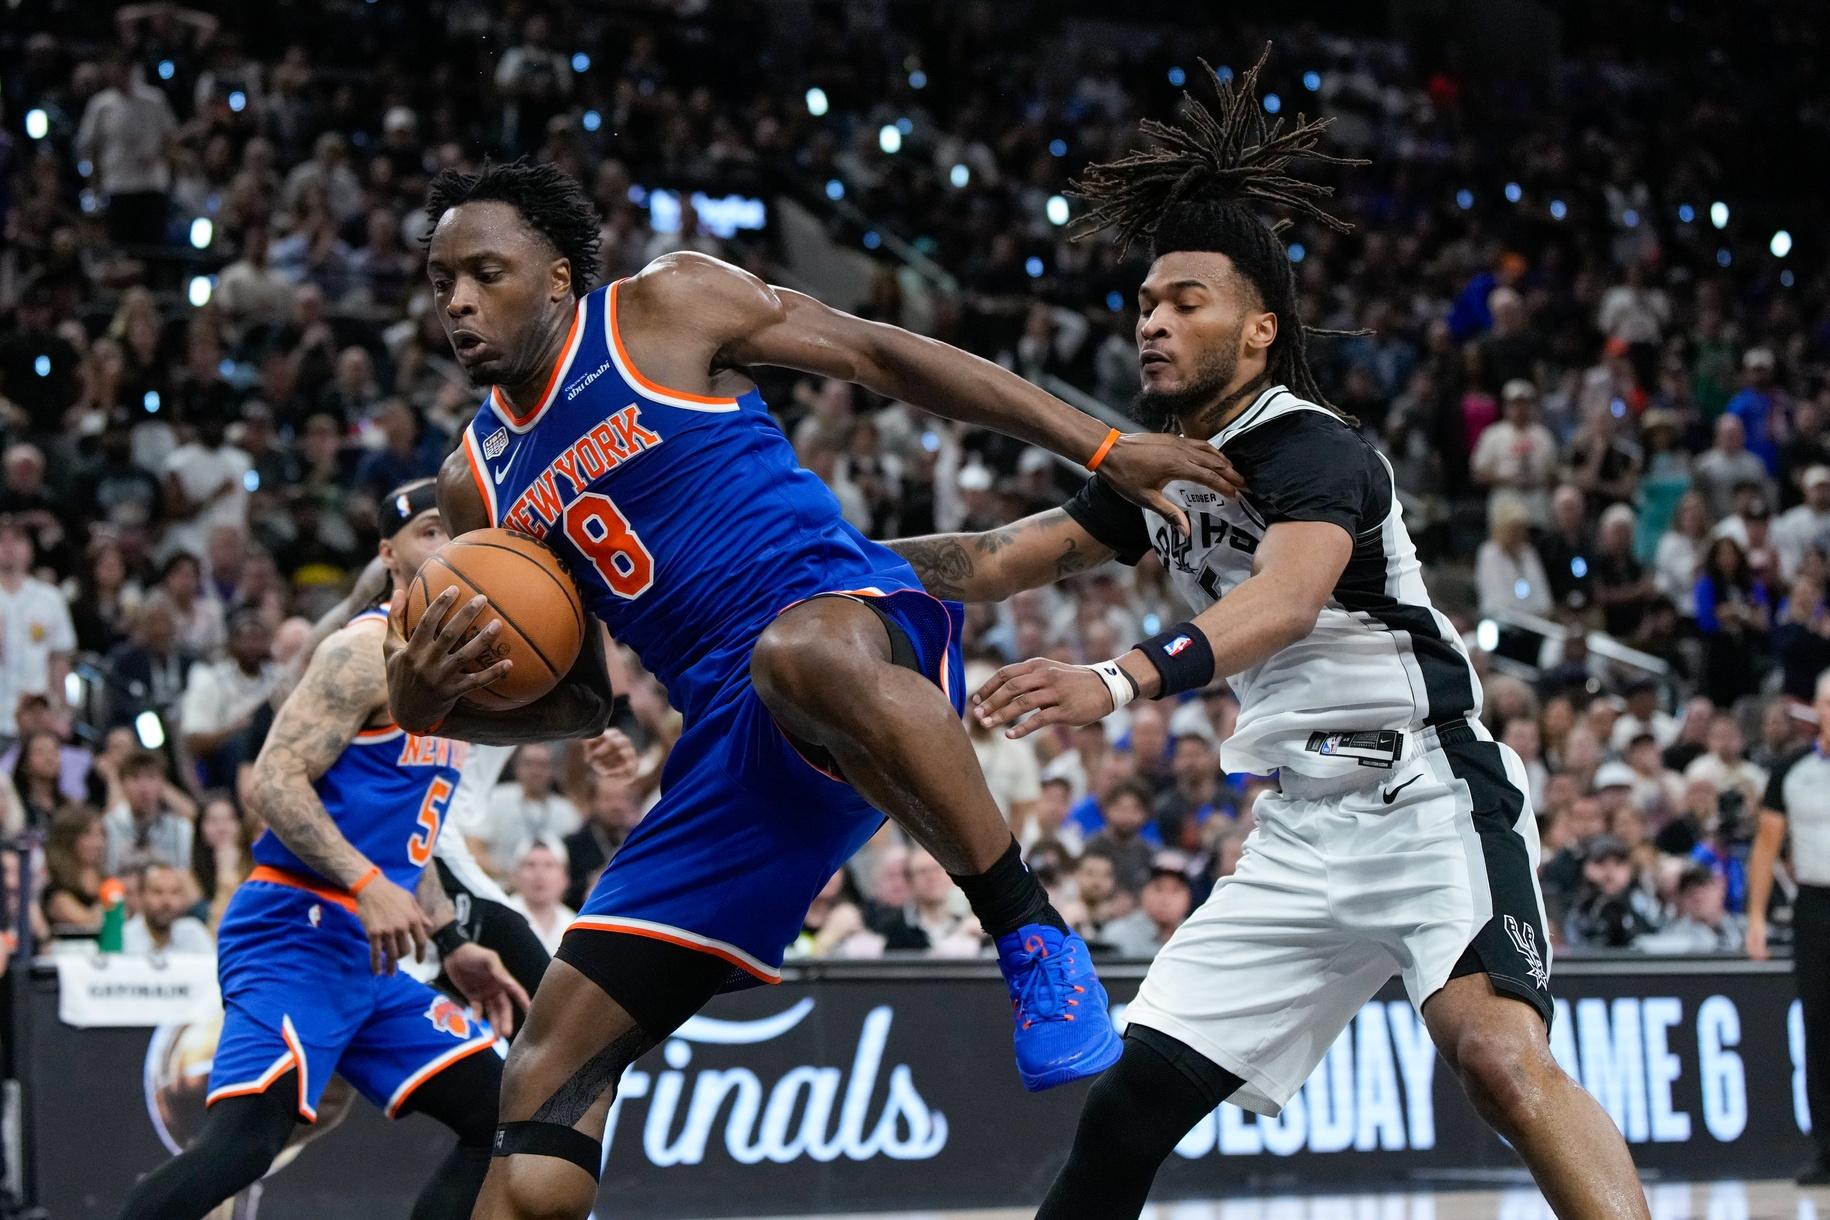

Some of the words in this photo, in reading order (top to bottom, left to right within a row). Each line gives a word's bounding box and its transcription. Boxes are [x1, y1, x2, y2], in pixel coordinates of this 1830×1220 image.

[567, 383, 585, 401] abu
[584, 359, 611, 386] dhabi
[553, 402, 663, 496] YORK
[563, 491, 655, 600] 8
[1185, 493, 1217, 504] LEDGER
[406, 774, 454, 868] 5
[1696, 994, 1748, 1143] 6
